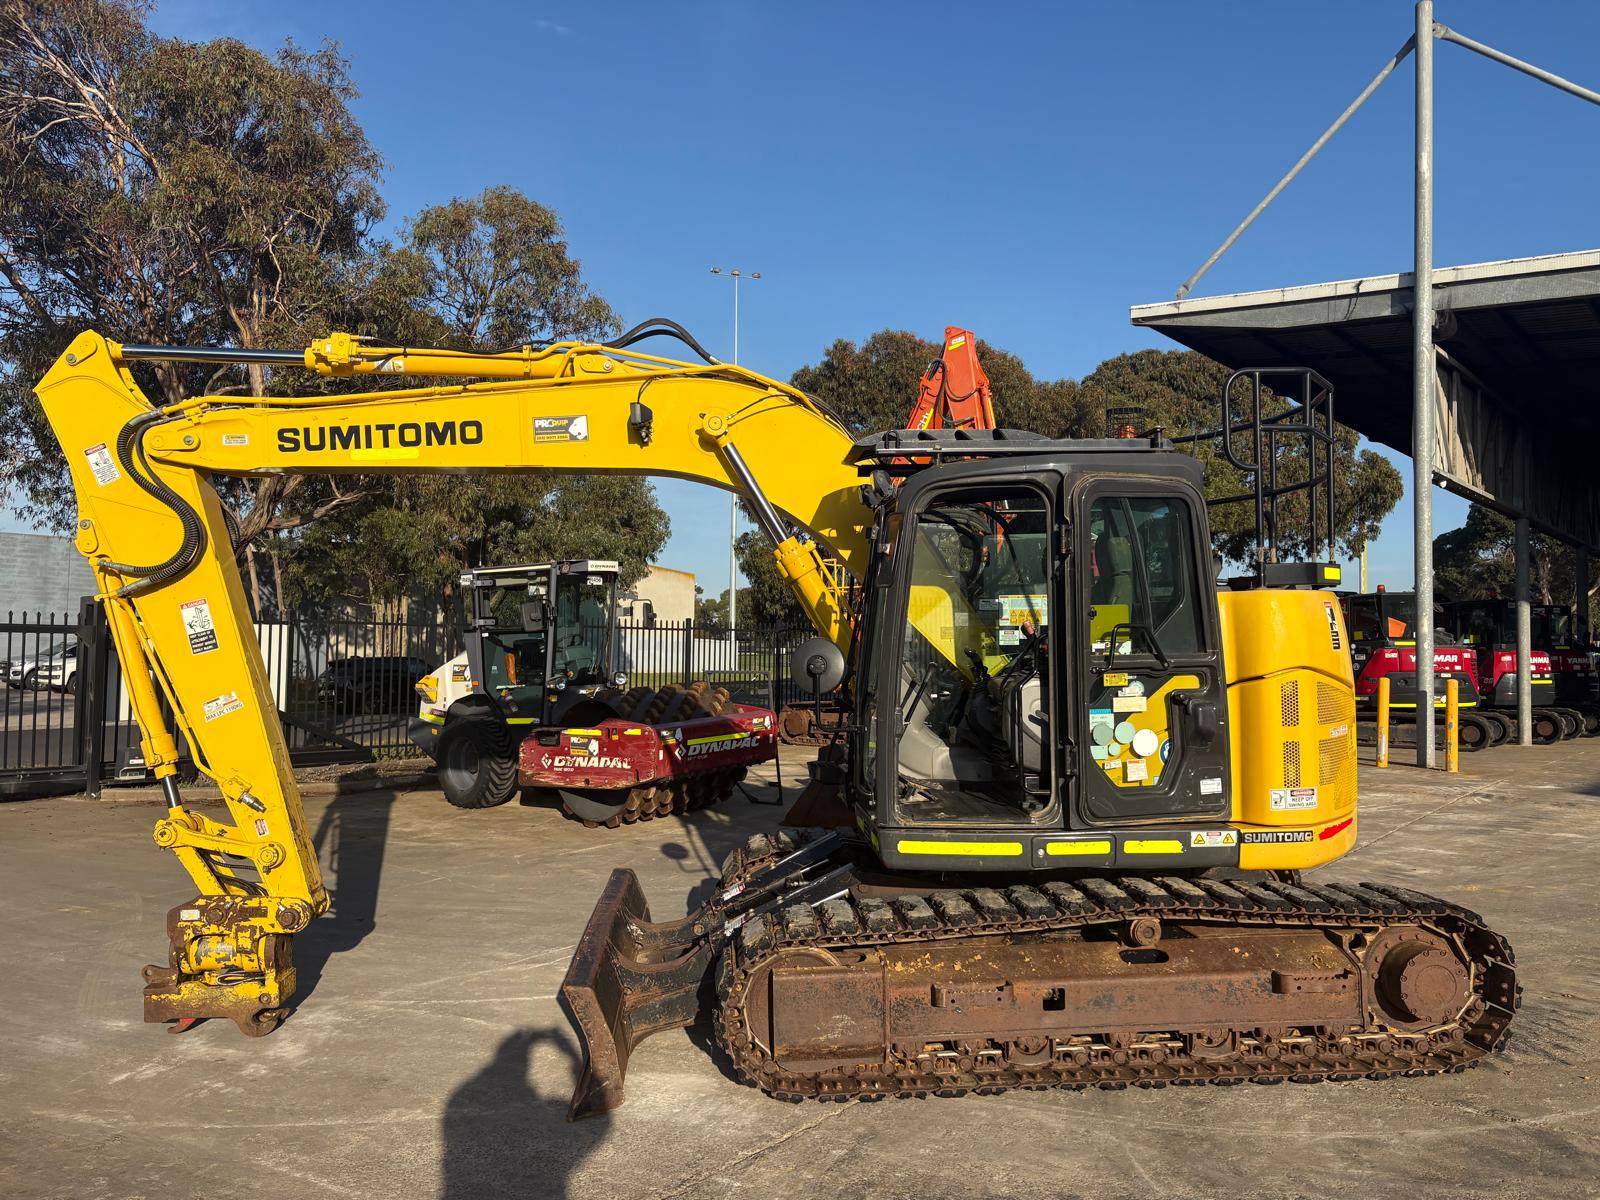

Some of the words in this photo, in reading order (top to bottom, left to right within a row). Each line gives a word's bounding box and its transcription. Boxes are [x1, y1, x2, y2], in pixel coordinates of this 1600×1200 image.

[277, 420, 483, 453] SUMITOMO
[1409, 654, 1458, 663] YMAR
[205, 711, 217, 721] MAX
[687, 736, 760, 757] DYNAPAC
